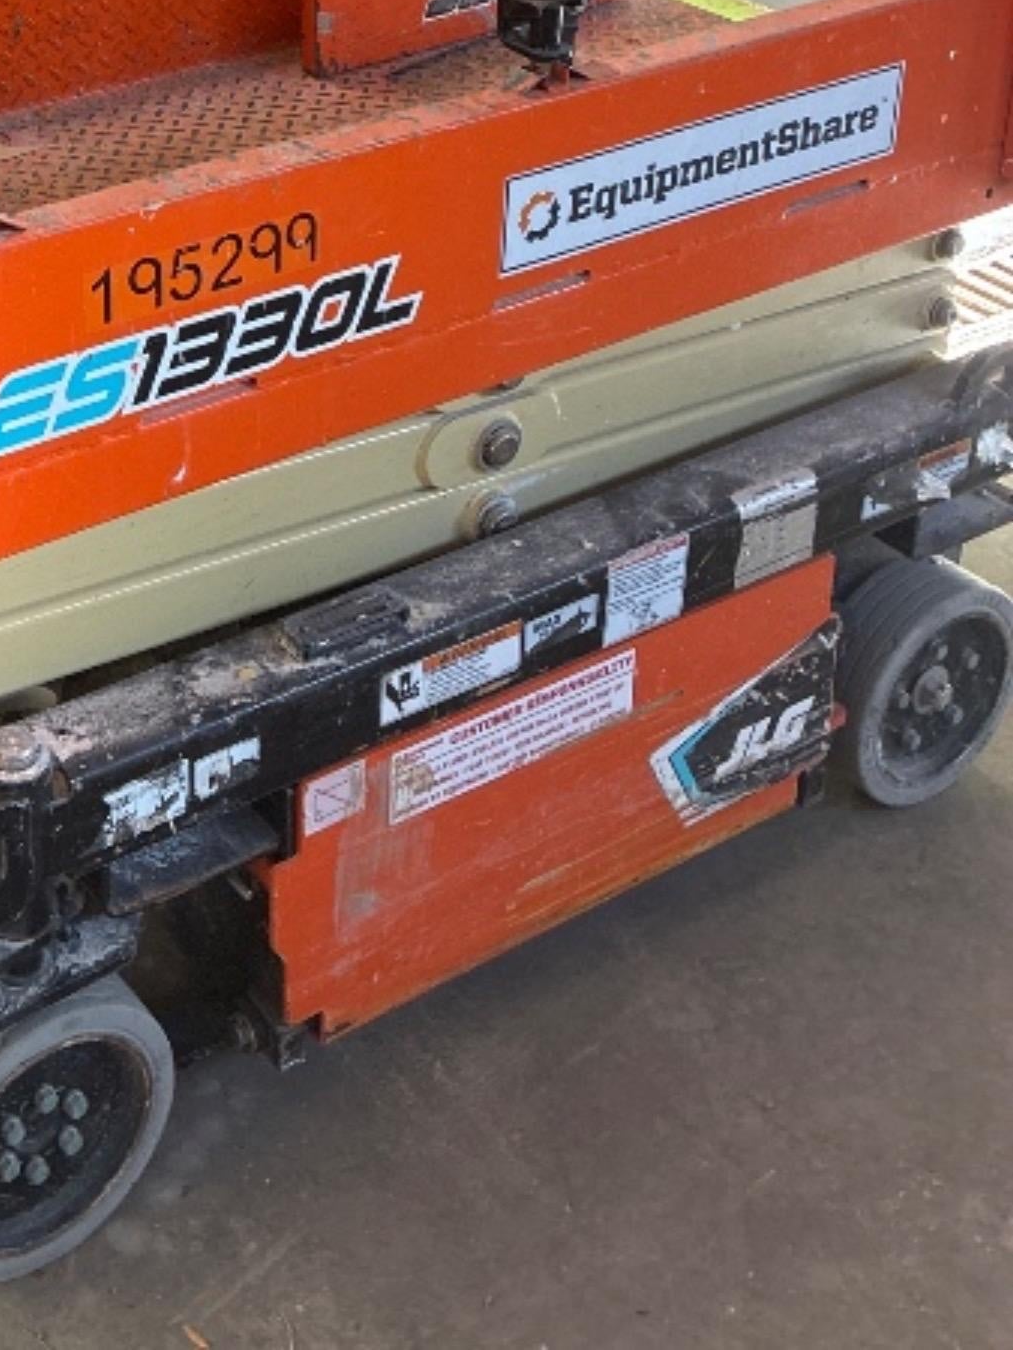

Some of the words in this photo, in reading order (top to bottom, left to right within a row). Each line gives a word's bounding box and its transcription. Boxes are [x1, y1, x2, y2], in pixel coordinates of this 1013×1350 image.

[567, 103, 880, 224] EquipmentShare
[90, 211, 319, 324] 195299
[714, 695, 817, 783] JLG
